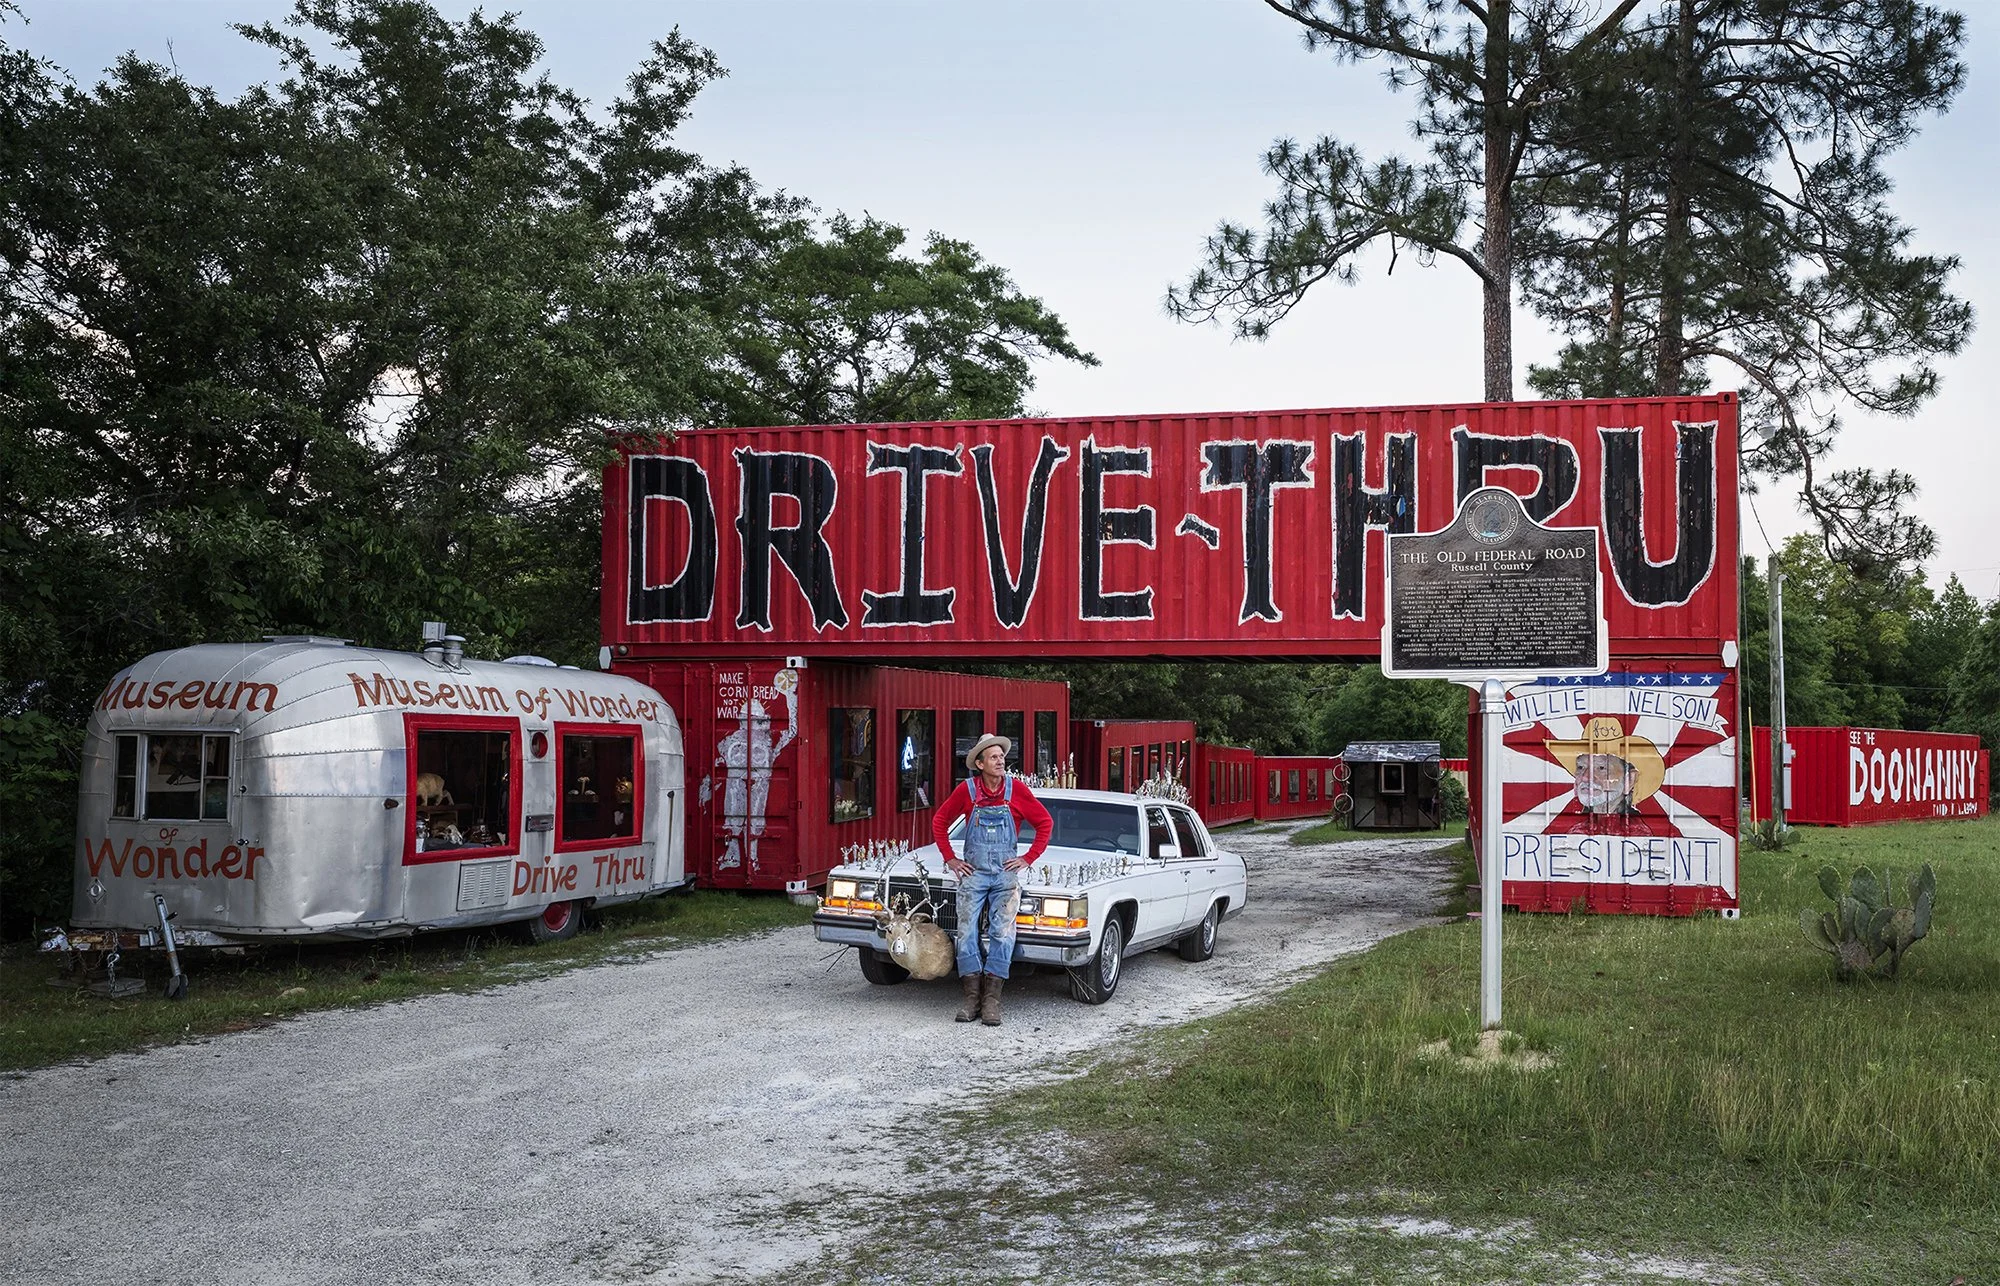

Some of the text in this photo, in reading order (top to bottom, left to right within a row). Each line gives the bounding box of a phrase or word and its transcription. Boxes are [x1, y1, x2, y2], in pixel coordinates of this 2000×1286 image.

[1400, 547, 1586, 564] THE OLD FEDERAL ROAD
[1451, 562, 1533, 572] Russell County
[719, 672, 744, 685] MAKE
[97, 679, 279, 713] Museum
[347, 672, 659, 722] Museum of Wonder
[719, 685, 779, 700] CORN BREAD
[717, 706, 740, 719] WAR
[1504, 690, 1712, 723] WILLIE NELSON
[1592, 719, 1621, 739] for
[1850, 731, 1875, 746] SEE THE
[1850, 746, 1978, 806] DOONANNY
[159, 827, 179, 847] of
[85, 838, 265, 881] Wonder
[1504, 835, 1718, 882] PRESIDENT
[512, 854, 645, 897] Drive Thru
